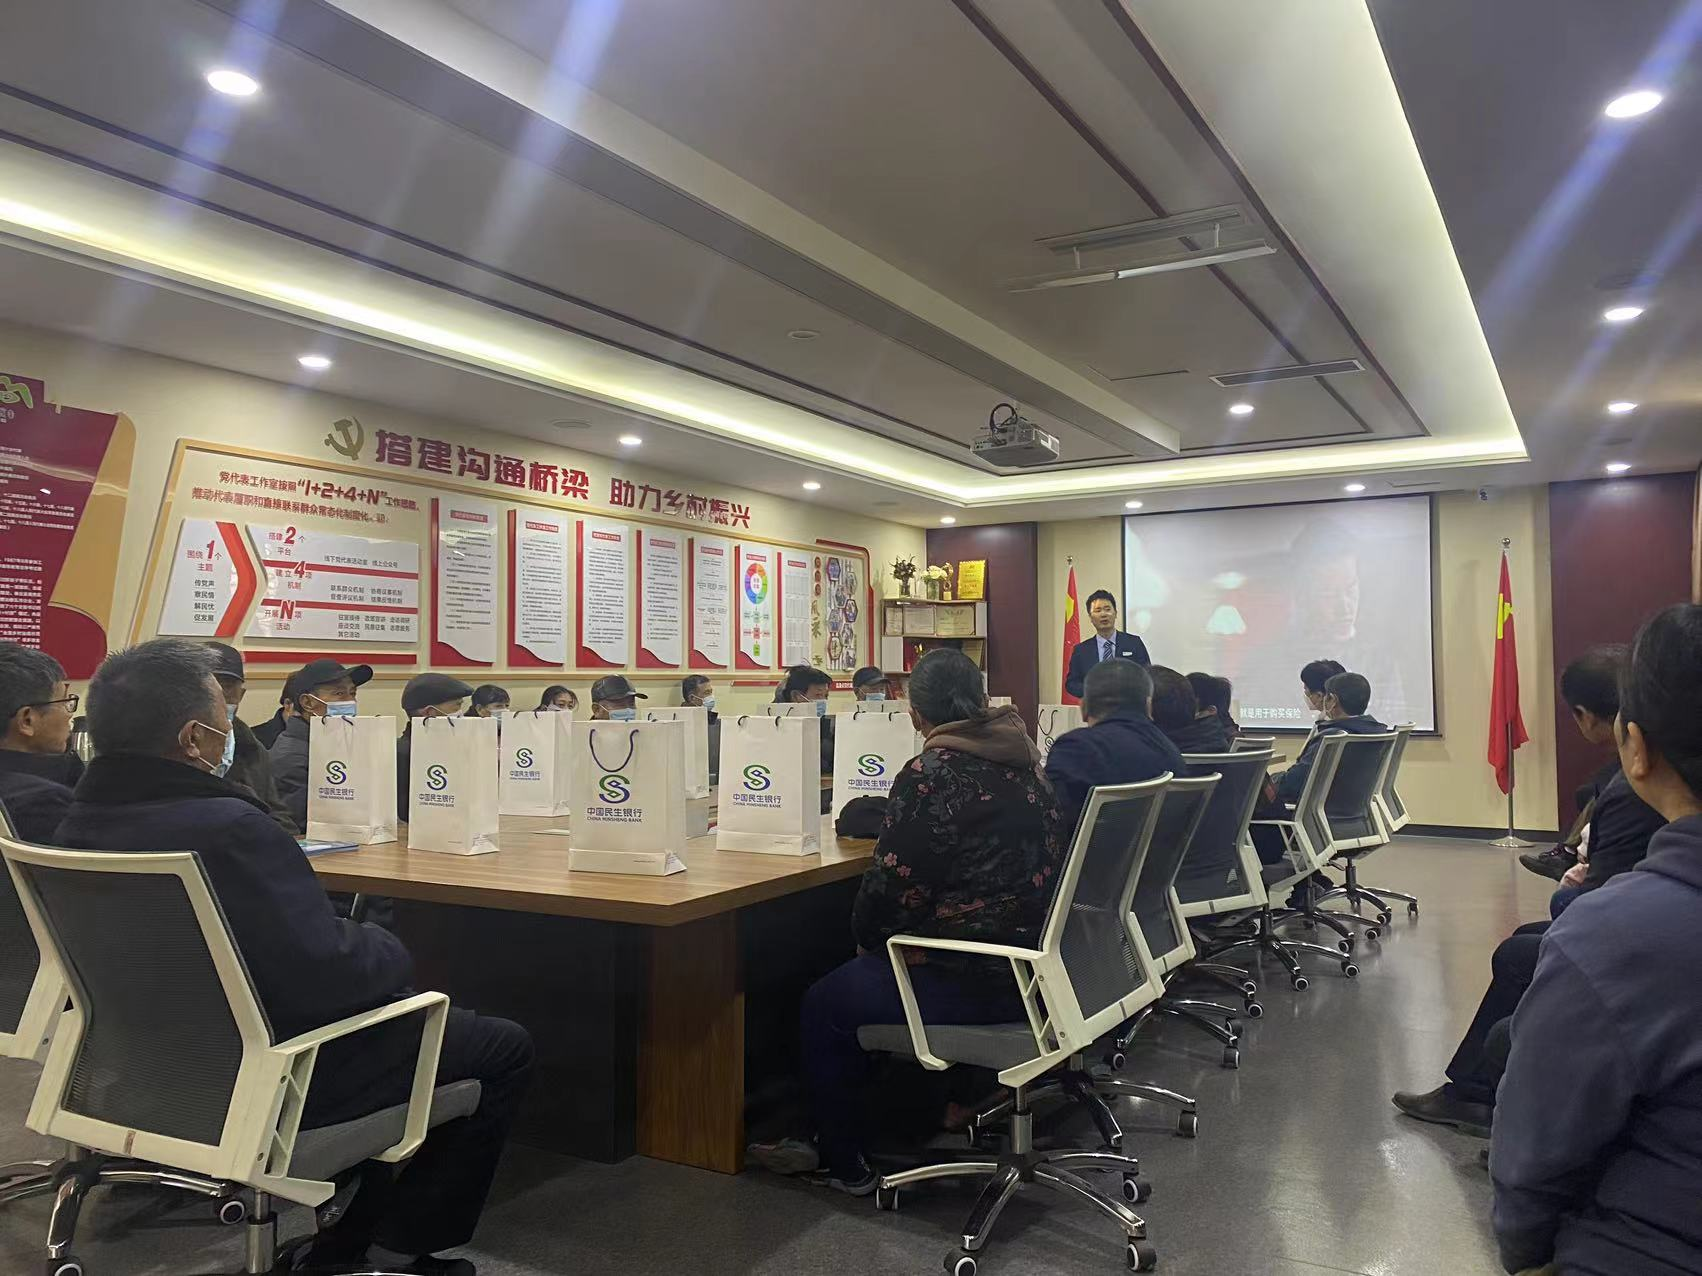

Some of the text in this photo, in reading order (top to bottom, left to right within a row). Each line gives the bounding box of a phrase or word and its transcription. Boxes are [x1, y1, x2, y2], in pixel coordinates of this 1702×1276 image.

[375, 429, 751, 529] 搭建沟通桥梁 助力乡村振兴
[276, 547, 292, 556] 平台
[509, 770, 541, 778] 中国民生银行
[318, 787, 355, 797] 中国民生银行
[418, 793, 455, 803] 中国民生银行
[732, 793, 782, 804] 中国民生银行
[586, 807, 643, 818] 中国民生银行
